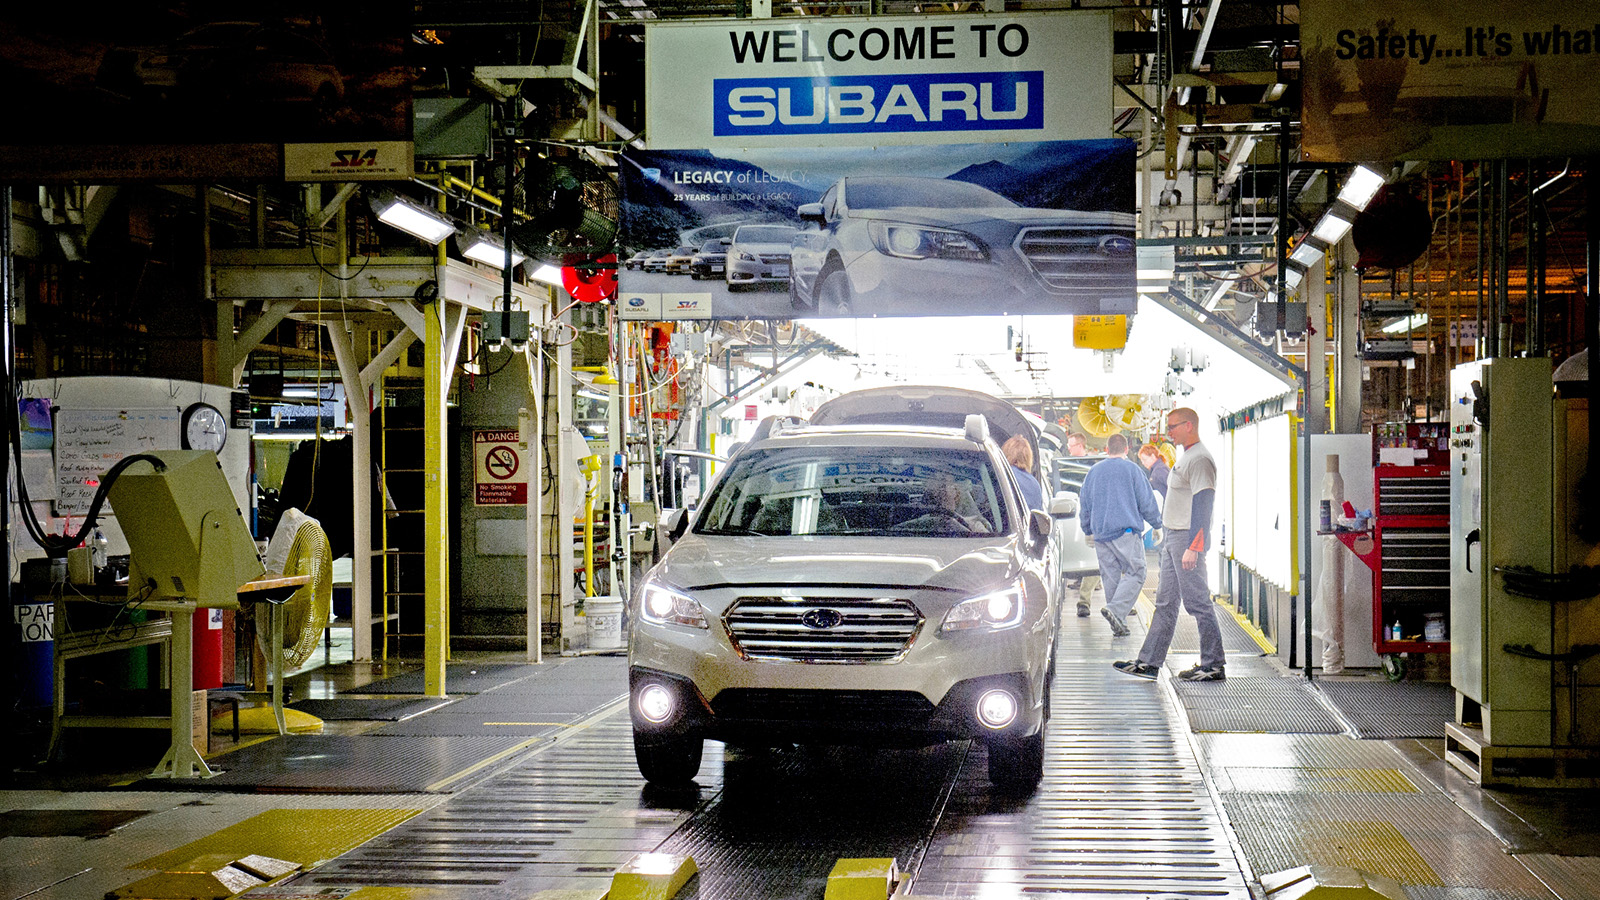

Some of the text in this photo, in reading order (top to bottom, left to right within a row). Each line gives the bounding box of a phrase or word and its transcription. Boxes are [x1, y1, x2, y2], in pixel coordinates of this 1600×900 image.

[729, 23, 1029, 63] WELCOME TO
[728, 81, 1029, 127] SUBARU
[673, 168, 810, 184] LEGACY of LEGACY.
[673, 193, 684, 202] 25
[685, 193, 711, 202] YEARS
[712, 193, 720, 202] of
[721, 192, 756, 201] BUILDING
[762, 192, 792, 201] LEGACY.
[487, 432, 519, 441] DANGE
